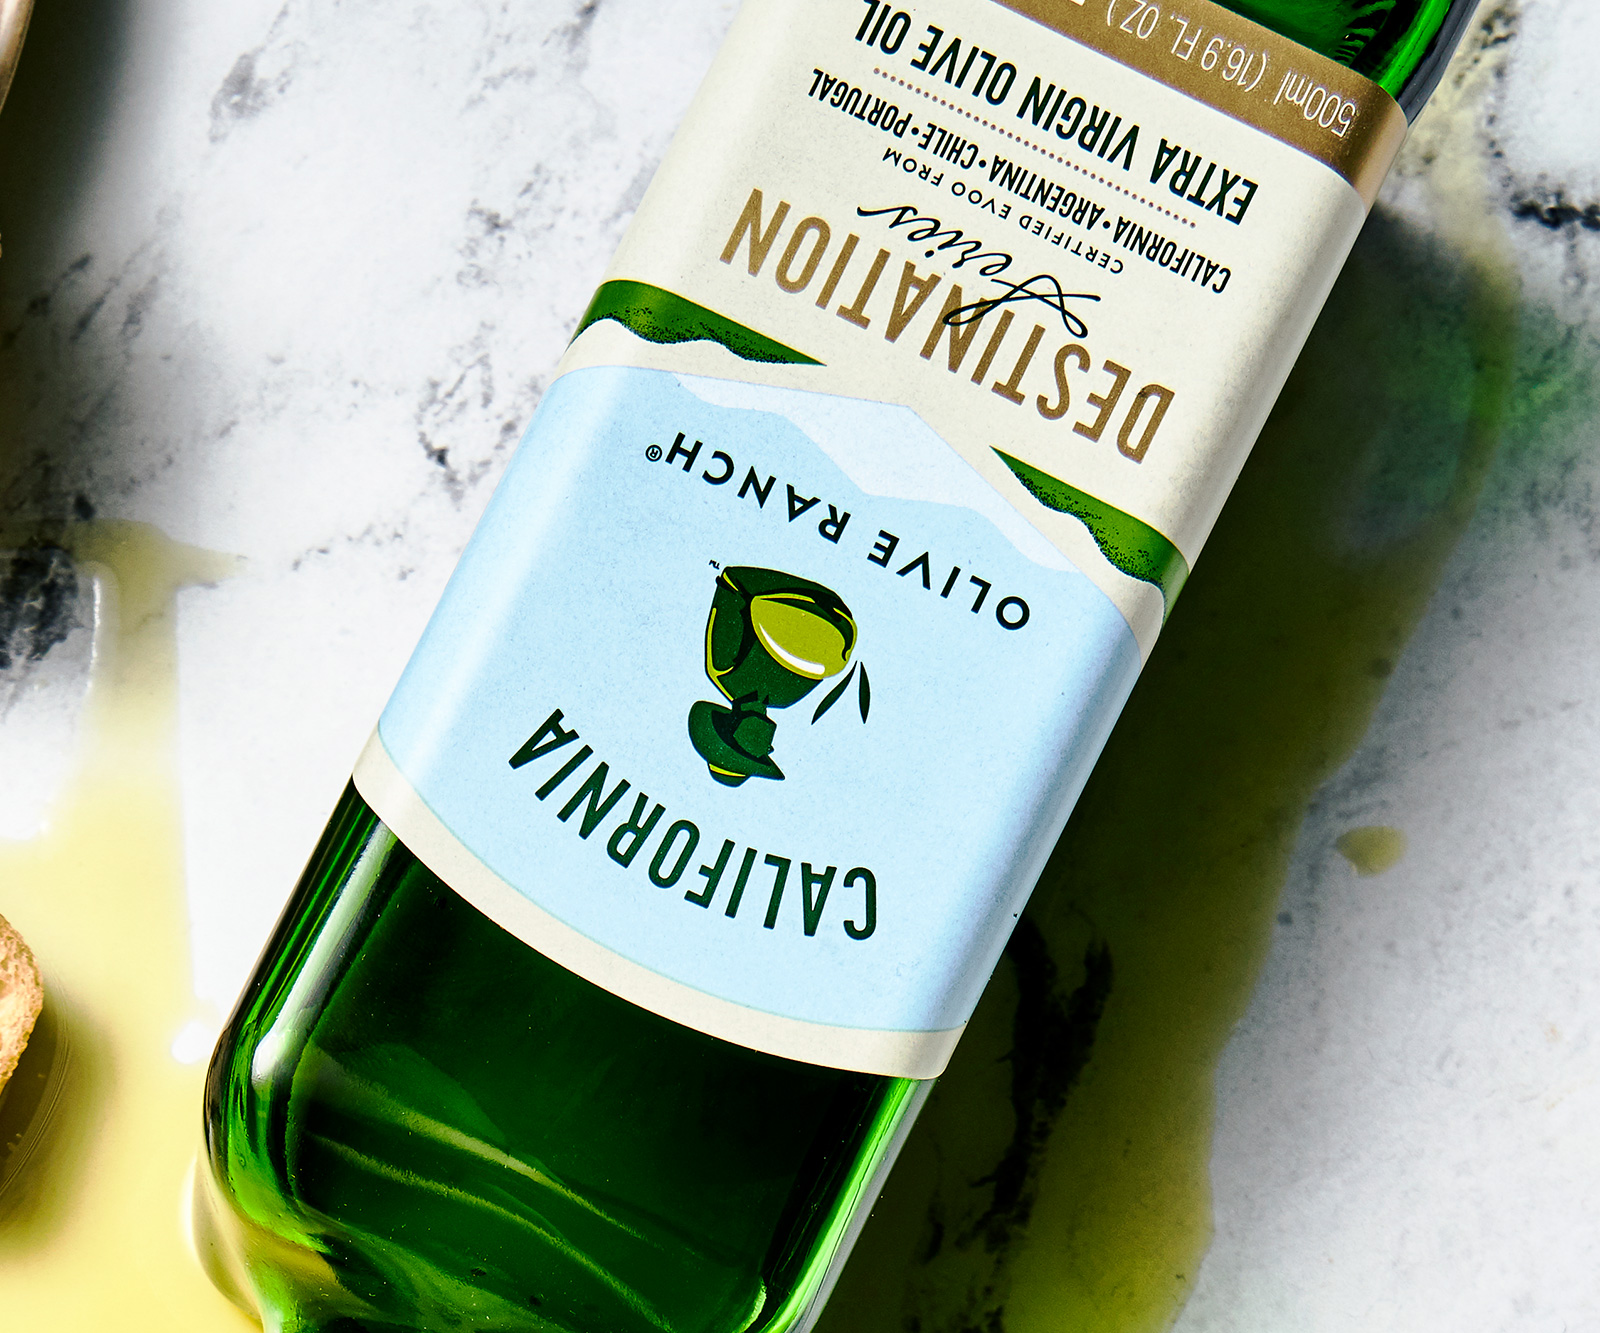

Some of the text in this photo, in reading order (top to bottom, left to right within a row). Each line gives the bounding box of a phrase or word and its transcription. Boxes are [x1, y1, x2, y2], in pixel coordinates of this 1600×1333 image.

[1169, 13, 1202, 61] FL.
[1200, 37, 1267, 93] (16.9
[854, 0, 1259, 226] EXTRA VIRGIN OLIVE OIL
[1272, 70, 1357, 138] 500ml
[856, 205, 1102, 339] Series
[882, 147, 1125, 275] CERTIFIED EVOO FROM
[718, 187, 1176, 465] DESTINATION
[866, 529, 1030, 631] OLIVE
[508, 708, 877, 942] CALIFORNIA
